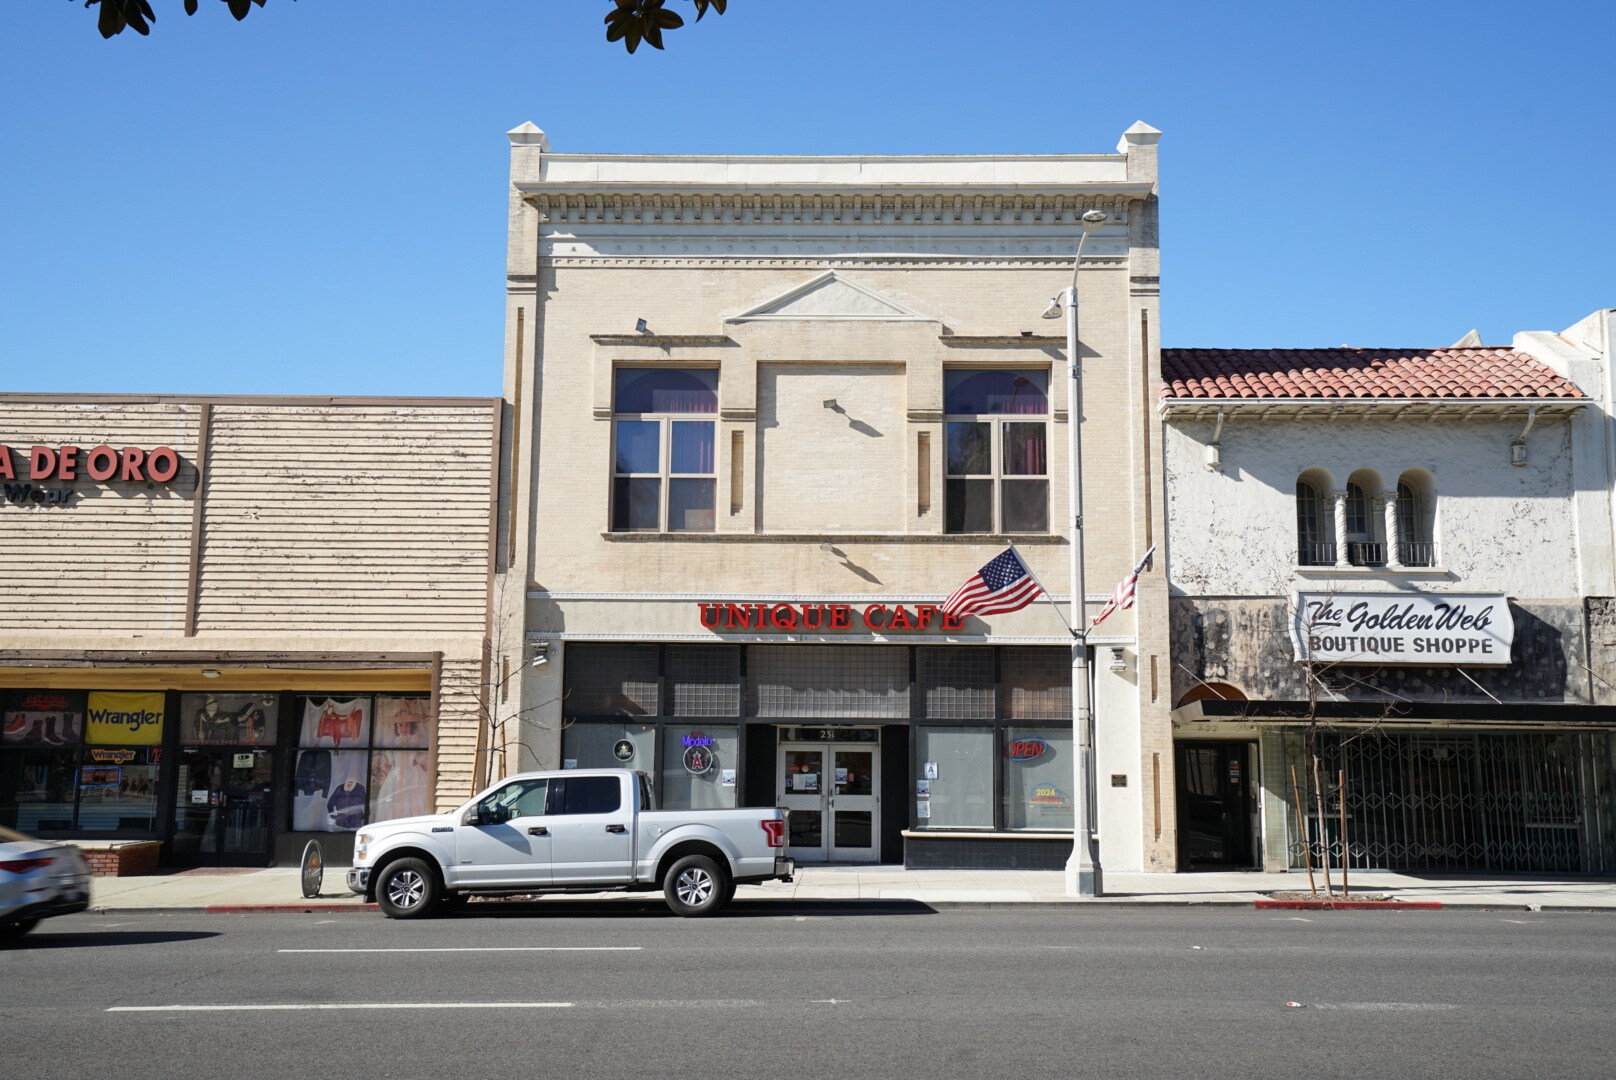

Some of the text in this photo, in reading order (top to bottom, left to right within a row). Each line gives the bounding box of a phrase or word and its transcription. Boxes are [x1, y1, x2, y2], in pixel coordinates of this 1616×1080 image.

[30, 446, 78, 480] DE
[86, 445, 178, 482] ORO
[3, 484, 74, 503] Wear
[698, 603, 852, 630] UNIQUE
[1308, 601, 1494, 633] The Golden Web
[1309, 636, 1493, 655] BOUTIQUE SHOPPE
[88, 709, 162, 731] Wrangler
[682, 735, 713, 746] Modelo
[1006, 742, 1044, 757] OPEN
[93, 750, 134, 763] Wrangler
[1036, 788, 1056, 797] 2024
